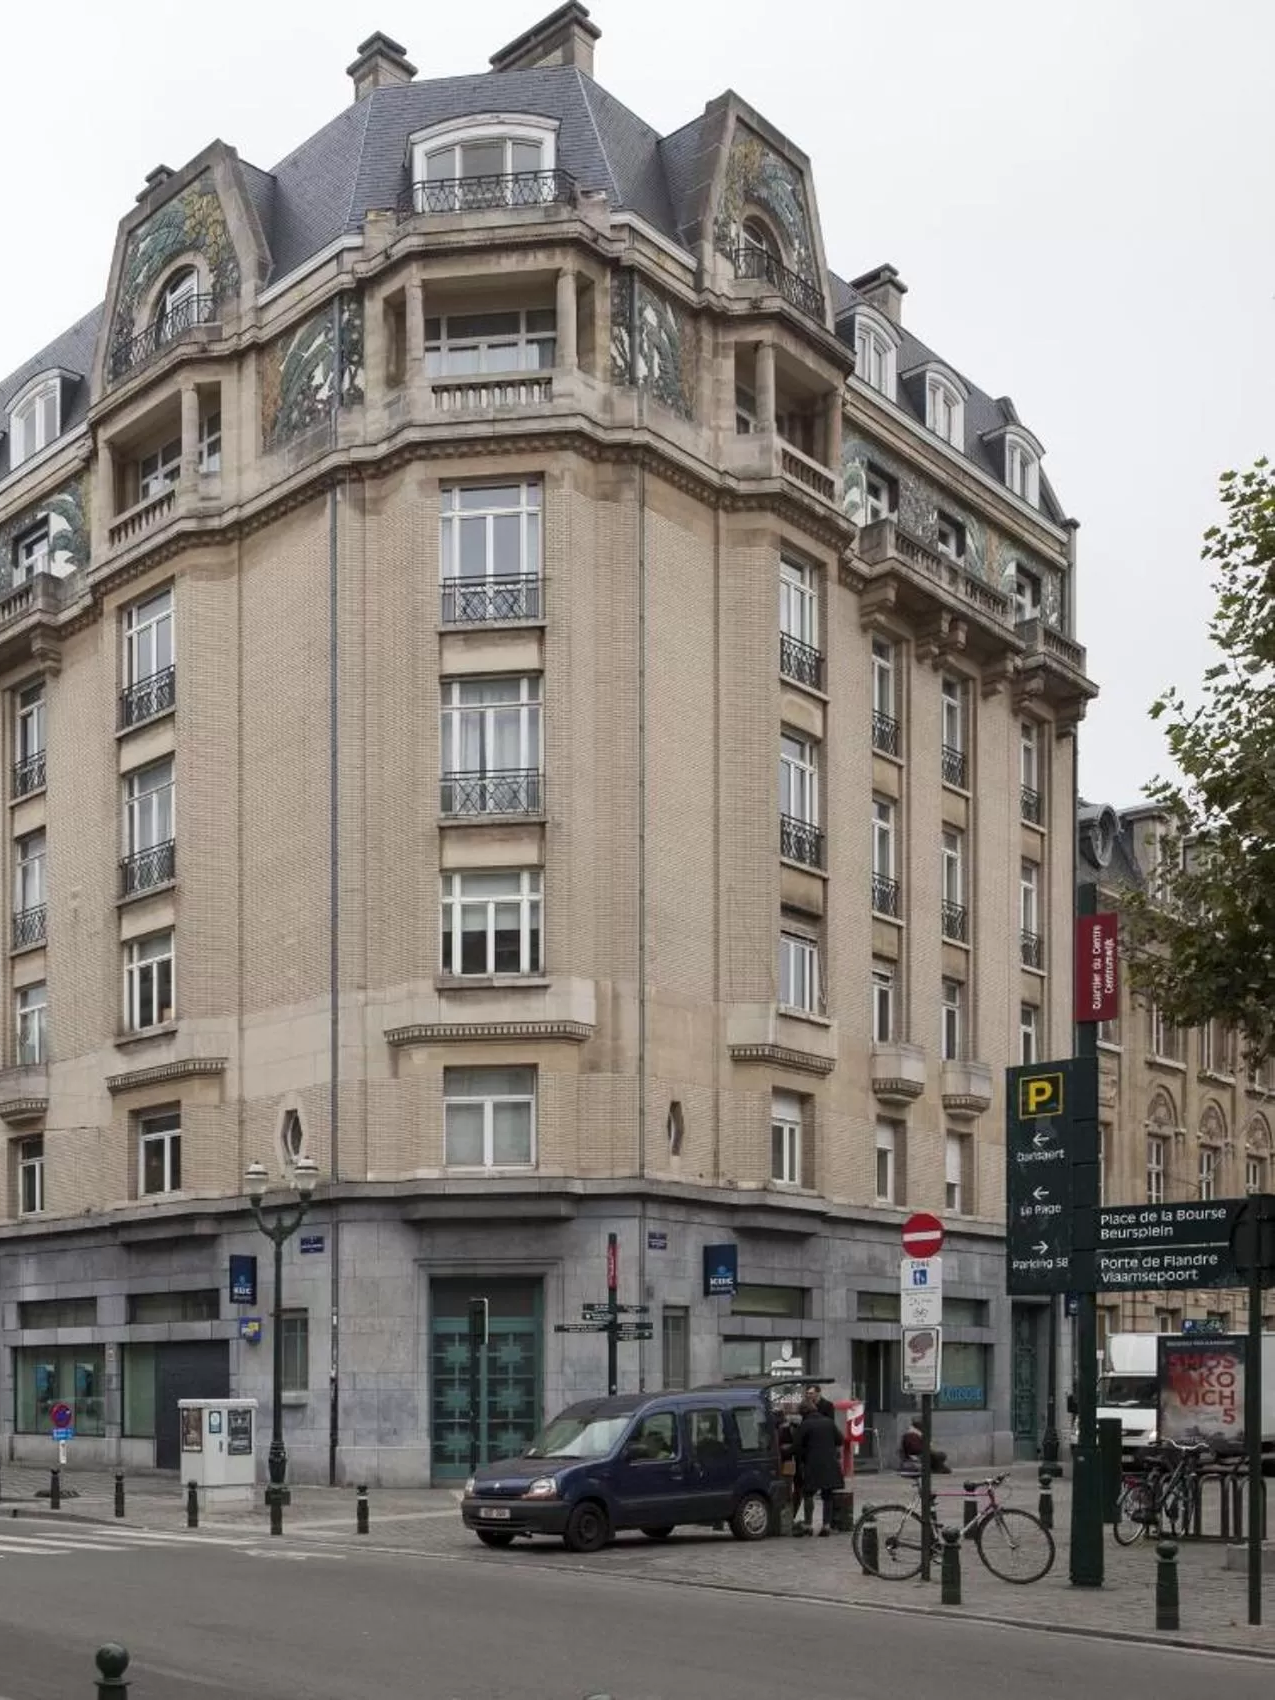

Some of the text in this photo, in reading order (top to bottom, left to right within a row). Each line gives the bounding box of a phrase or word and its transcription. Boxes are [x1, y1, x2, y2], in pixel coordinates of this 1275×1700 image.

[1093, 925, 1102, 954] Centre
[1093, 958, 1102, 970] du
[1028, 1081, 1053, 1112] P
[1016, 1149, 1065, 1162] Dansaert
[1100, 1208, 1226, 1226] Place de la Bourse
[1100, 1226, 1173, 1240] Beursplein
[1012, 1258, 1053, 1270] Parking
[1100, 1254, 1218, 1269] Porte de Flandre
[1101, 1269, 1199, 1283] Vlaamsepoort
[1176, 1390, 1235, 1406] VICH
[1223, 1408, 1236, 1424] 5
